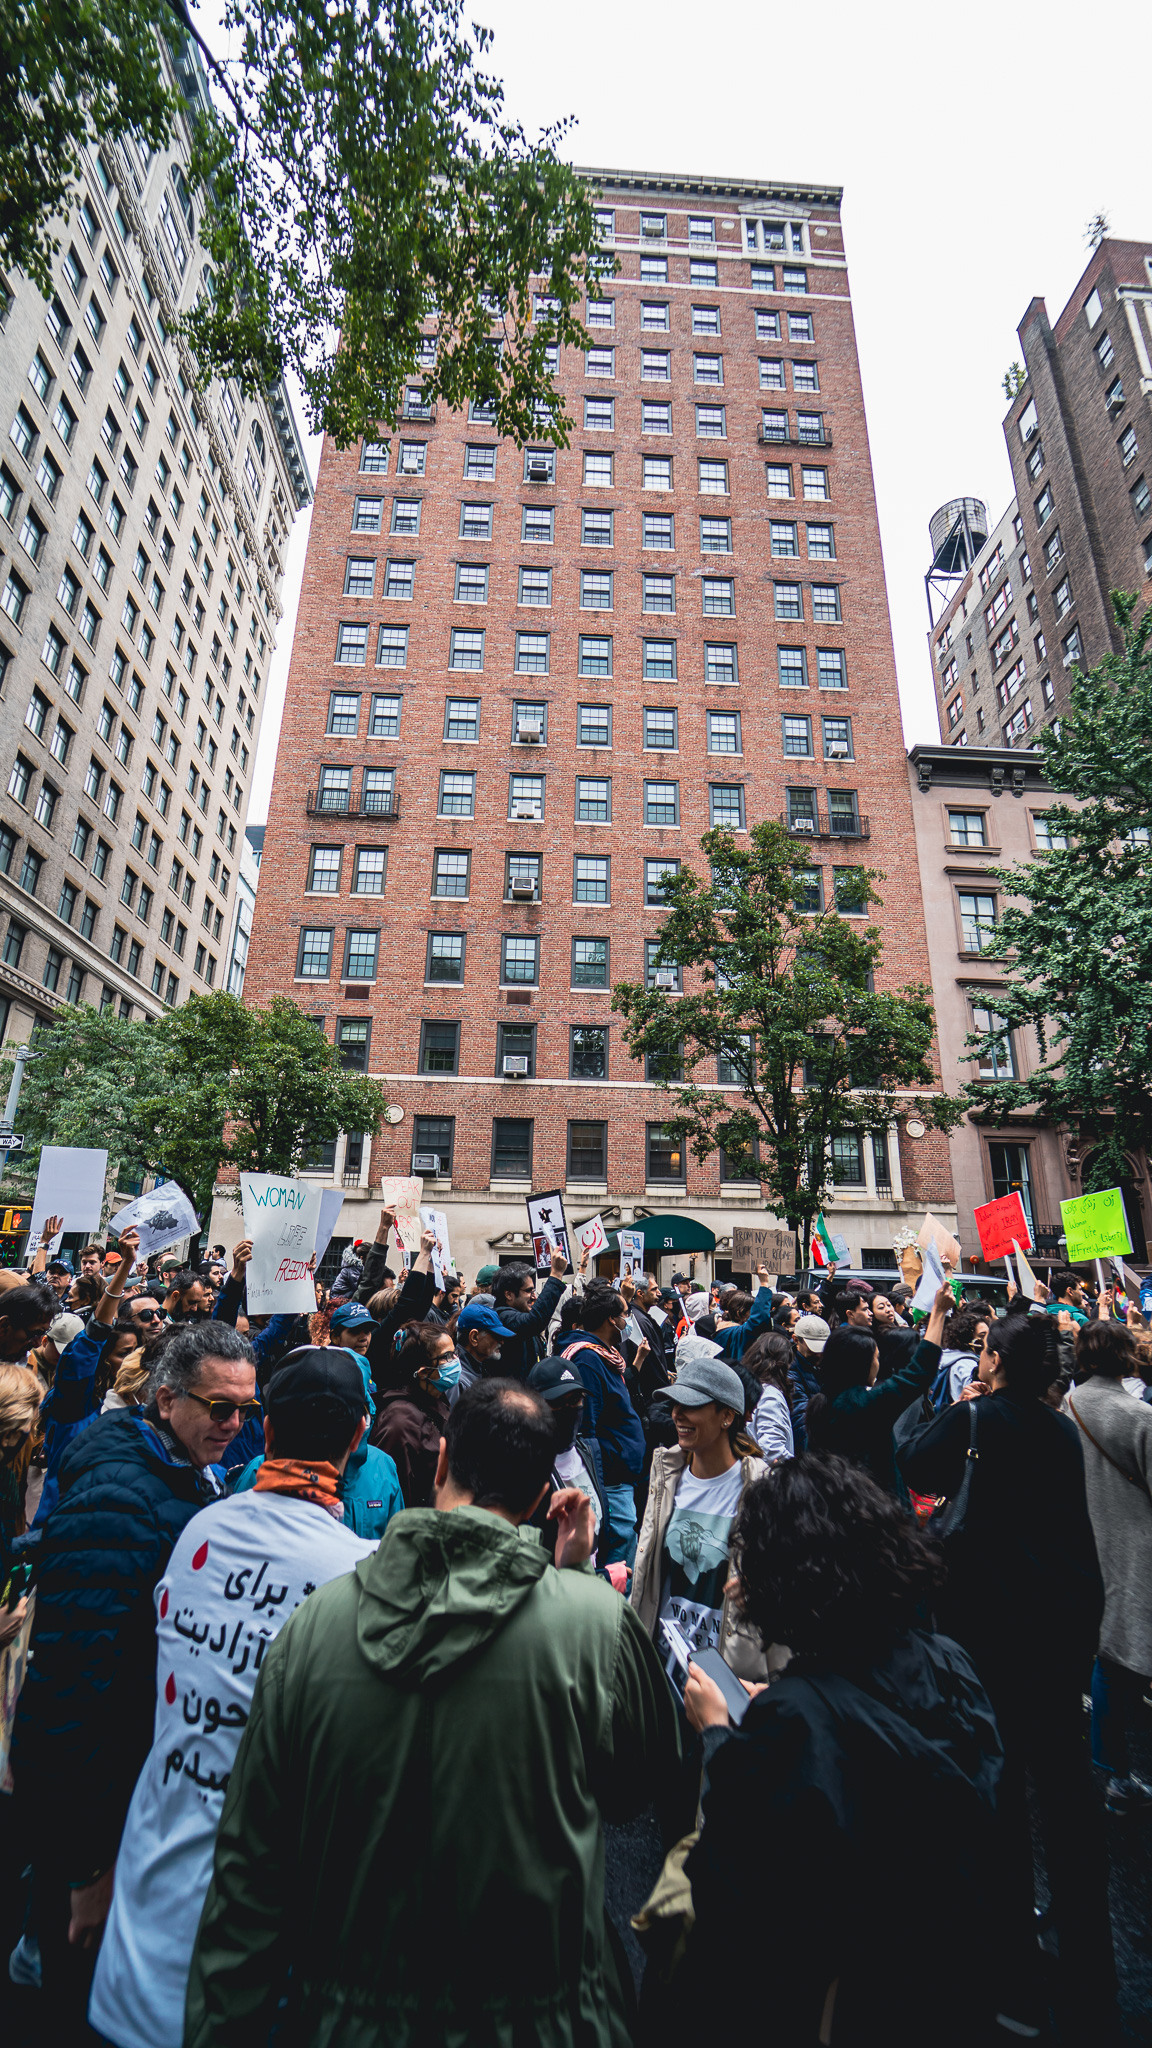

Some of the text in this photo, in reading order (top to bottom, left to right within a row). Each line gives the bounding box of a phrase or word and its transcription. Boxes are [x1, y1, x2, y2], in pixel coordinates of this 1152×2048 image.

[384, 1178, 420, 1197] SPEAK
[249, 1184, 306, 1210] WOMAN
[397, 1196, 419, 1210] OUT
[1103, 1194, 1115, 1207] زن
[1000, 1212, 1020, 1229] IRAN
[581, 1222, 603, 1249] زن
[663, 1237, 674, 1248] 51
[735, 1228, 753, 1241] FROM
[754, 1231, 768, 1246] NY
[735, 1244, 754, 1258] FUCK
[755, 1246, 768, 1259] THE
[223, 1561, 289, 1618] برای
[671, 1603, 721, 1635] WOMAN
[173, 1606, 272, 1675] آزادیت
